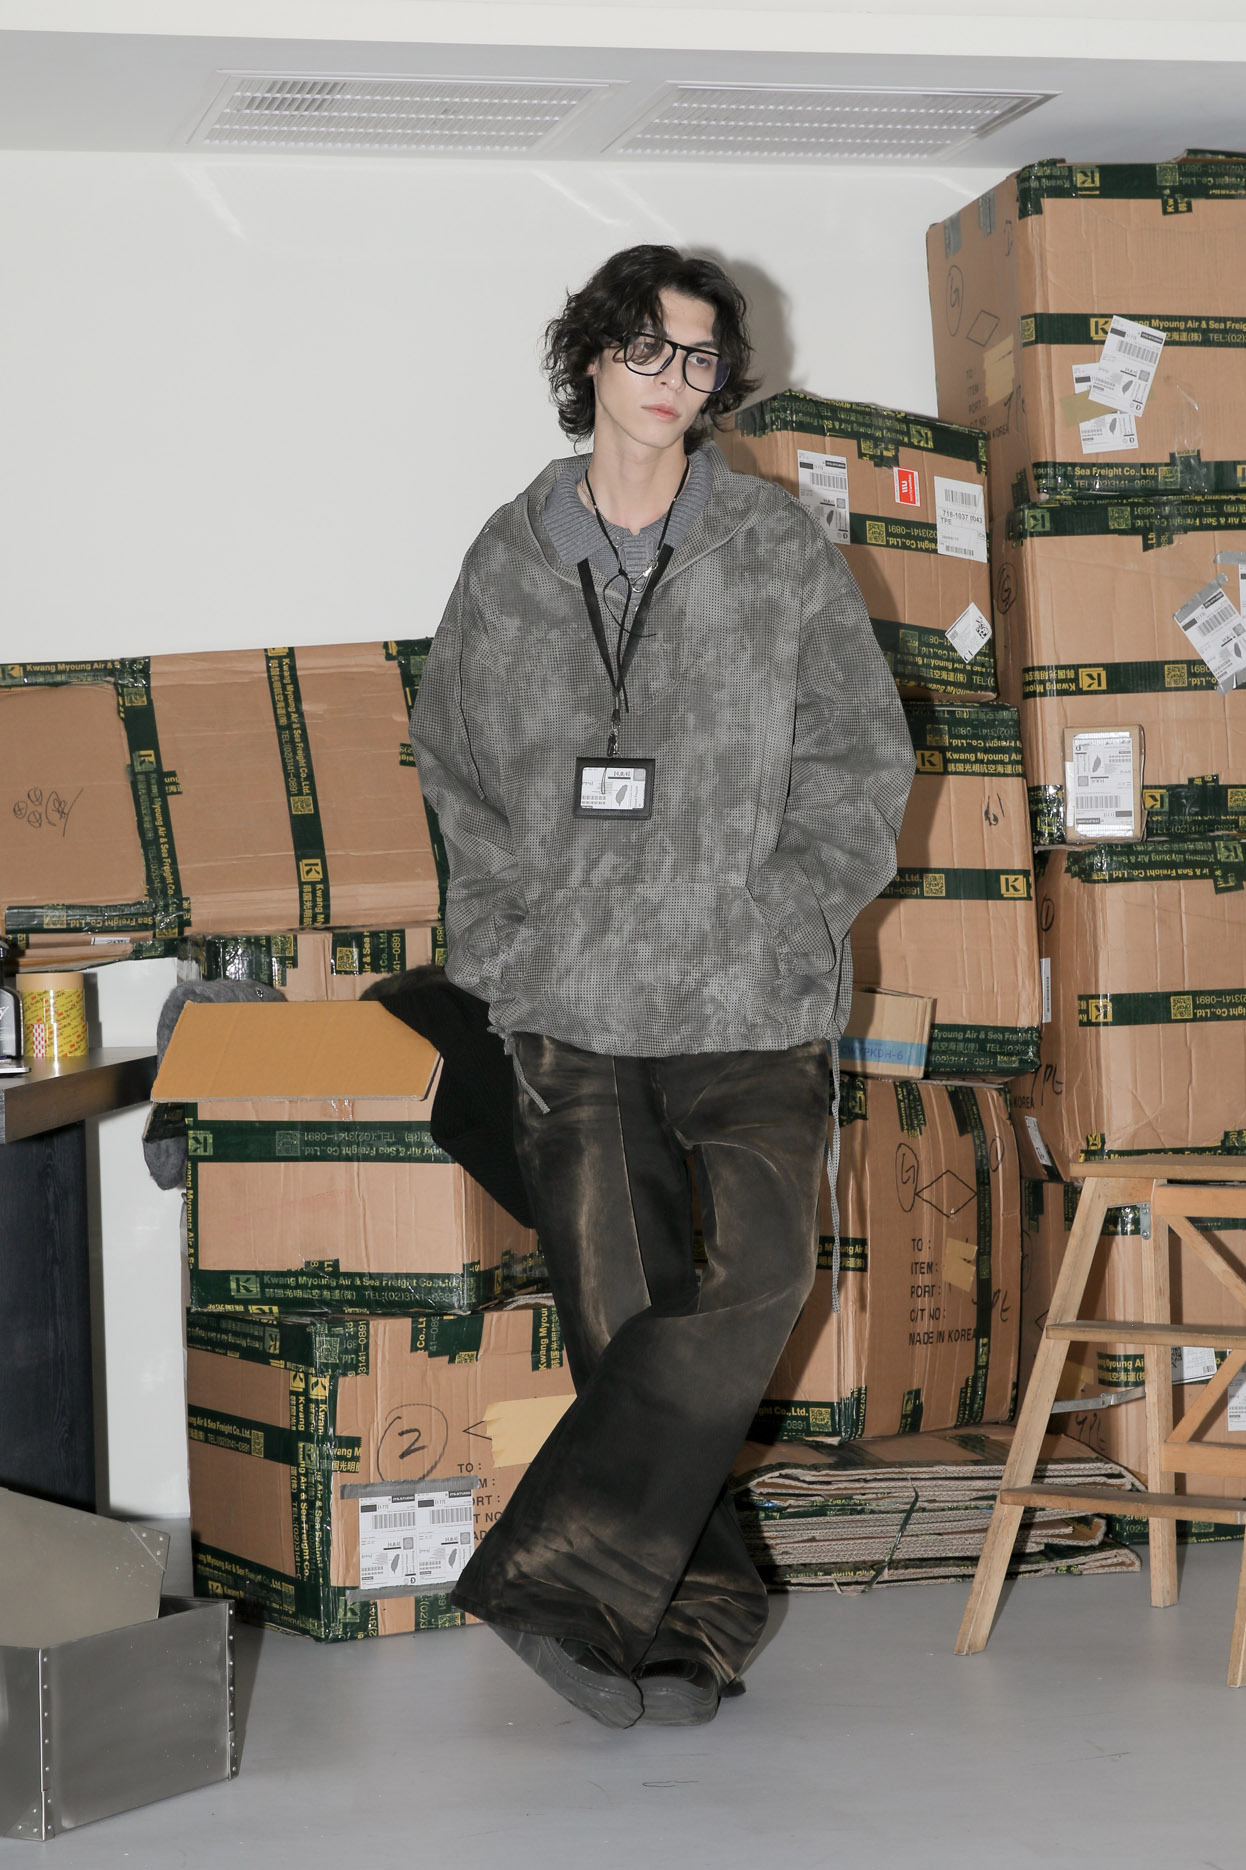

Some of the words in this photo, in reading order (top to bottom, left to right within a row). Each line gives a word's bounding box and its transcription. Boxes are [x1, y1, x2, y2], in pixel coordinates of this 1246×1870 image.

[1151, 319, 1185, 330] Myoung
[1187, 319, 1199, 328] Air
[1200, 320, 1207, 328] &
[1208, 320, 1225, 329] Sea
[1074, 467, 1091, 476] Sea
[1092, 466, 1122, 477] Freight
[917, 540, 938, 551] reight
[26, 663, 56, 673] Kwang
[58, 663, 91, 672] Myoung
[93, 662, 104, 670] Air
[1188, 677, 1217, 686] o.,Ltd.
[284, 684, 295, 712] Myoung
[295, 743, 307, 768] Freight
[945, 751, 975, 762] Kwang
[976, 752, 1009, 763] Myoung
[893, 873, 922, 882] o.,Ltd.
[315, 884, 324, 913] Kwang
[363, 936, 371, 953] Sea
[1193, 1007, 1228, 1018] Co.,Ltd.
[965, 1030, 977, 1039] Air
[341, 1146, 375, 1157] Freight
[378, 1147, 397, 1156] Sea
[911, 1238, 924, 1251] TO
[910, 1261, 933, 1275] ITEM
[264, 1275, 296, 1287] Kwang
[298, 1275, 337, 1288] Myoung
[339, 1276, 352, 1285] Air
[354, 1276, 361, 1286] &
[363, 1277, 380, 1286] Sea
[382, 1278, 417, 1289] Freight
[910, 1285, 936, 1298] PORT
[909, 1331, 934, 1346] MADE
[936, 1330, 945, 1343] IN
[948, 1328, 976, 1343] KOREA
[538, 1338, 548, 1371] Kwang
[1134, 1358, 1144, 1368] Ai
[297, 1396, 305, 1431] Kwang
[318, 1403, 328, 1436] Kwan
[398, 1427, 428, 1460] 2
[457, 1462, 474, 1474] TO
[299, 1475, 308, 1489] Air
[300, 1502, 308, 1521] Sea
